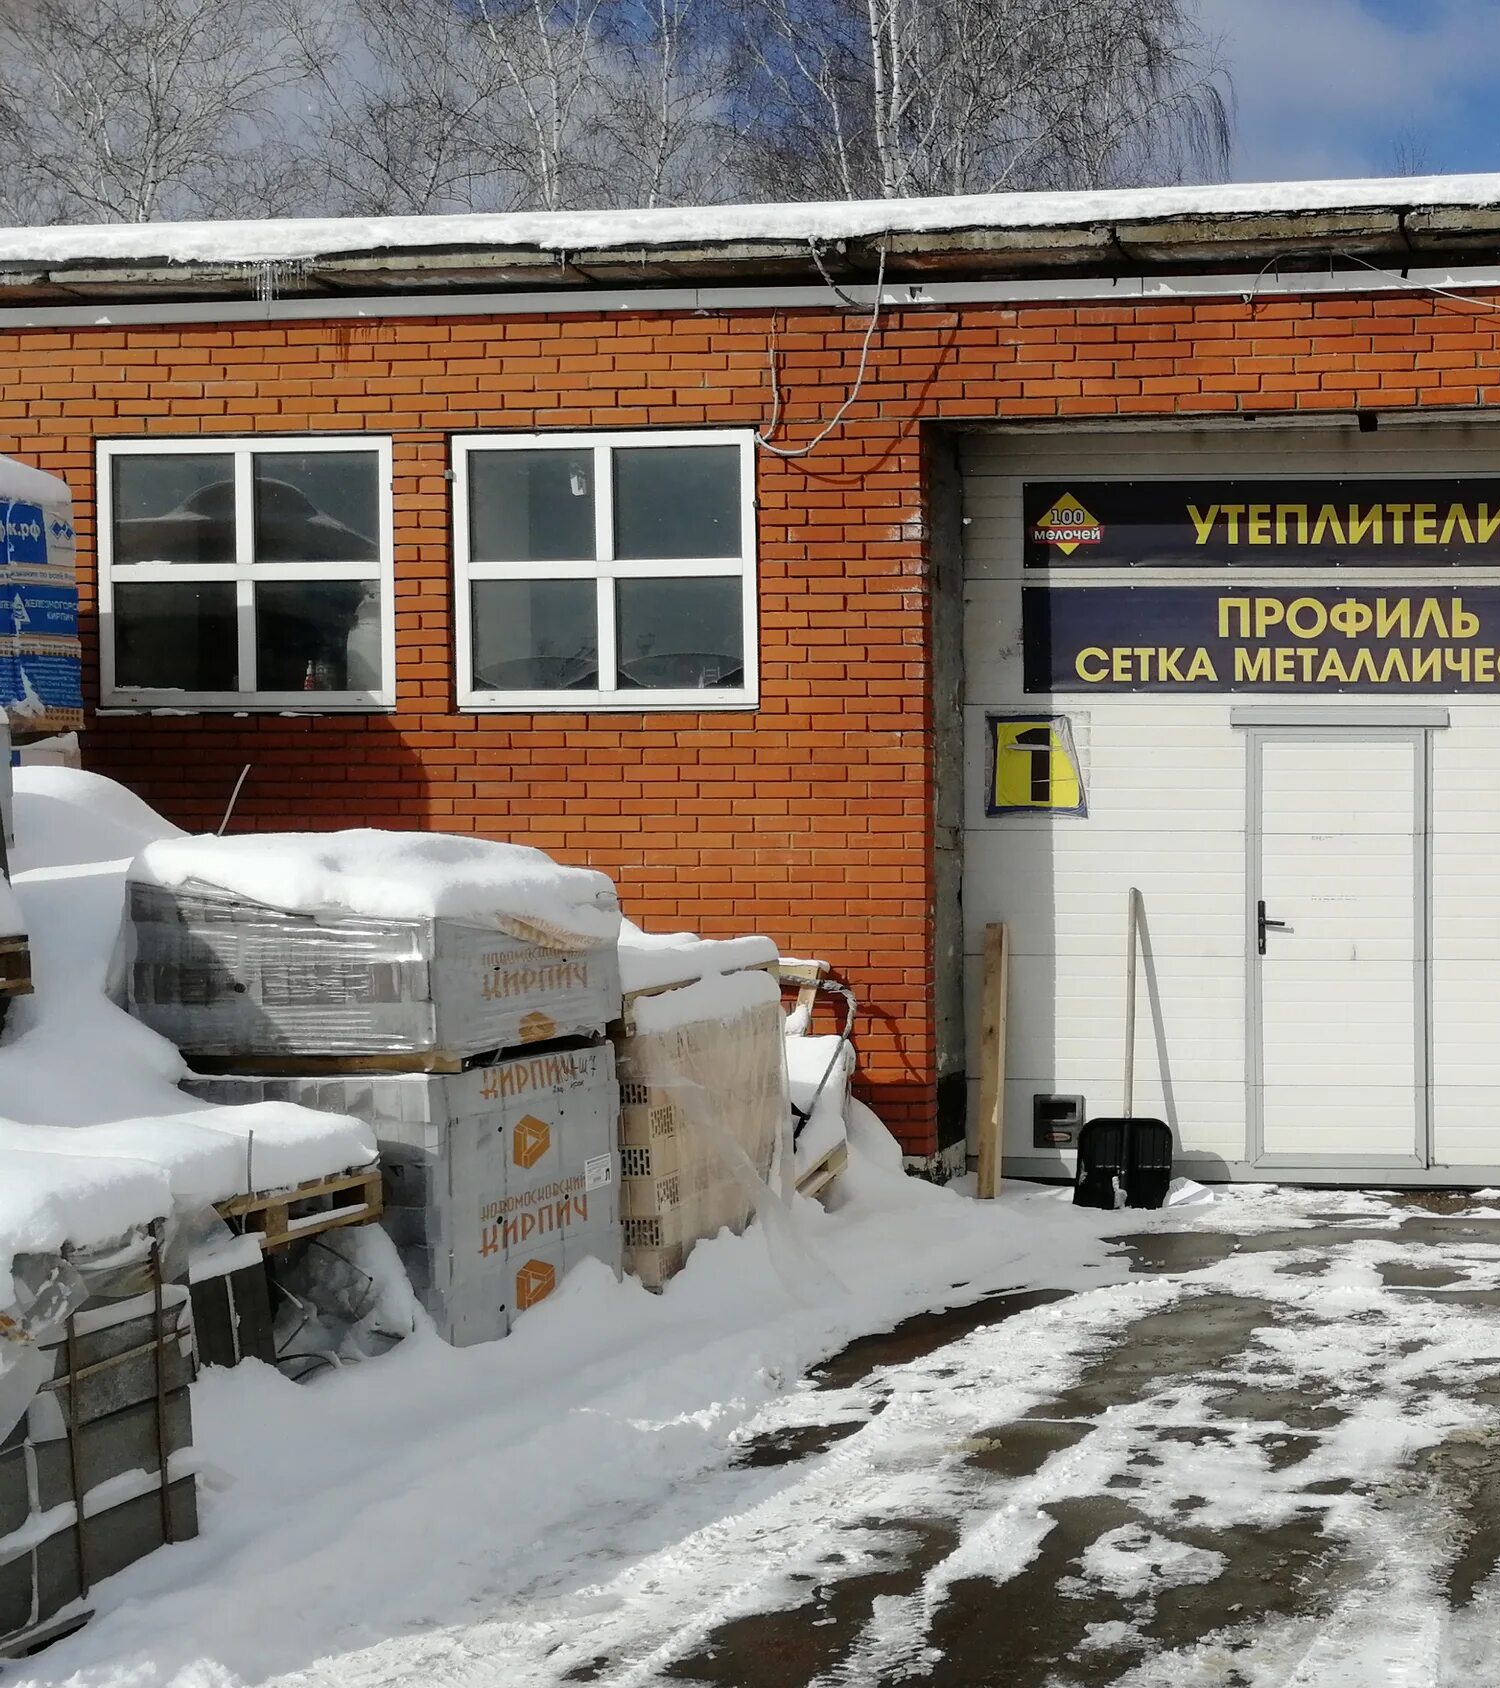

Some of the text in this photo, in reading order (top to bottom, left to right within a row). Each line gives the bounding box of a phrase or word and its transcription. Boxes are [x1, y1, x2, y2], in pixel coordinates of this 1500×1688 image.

[1034, 527, 1101, 541] мелочей
[1051, 509, 1084, 525] 100
[1218, 597, 1480, 640] ПРОФИЛЬ
[1075, 646, 1218, 683] СЕТКА
[478, 1193, 588, 1258] КИРПИЧ
